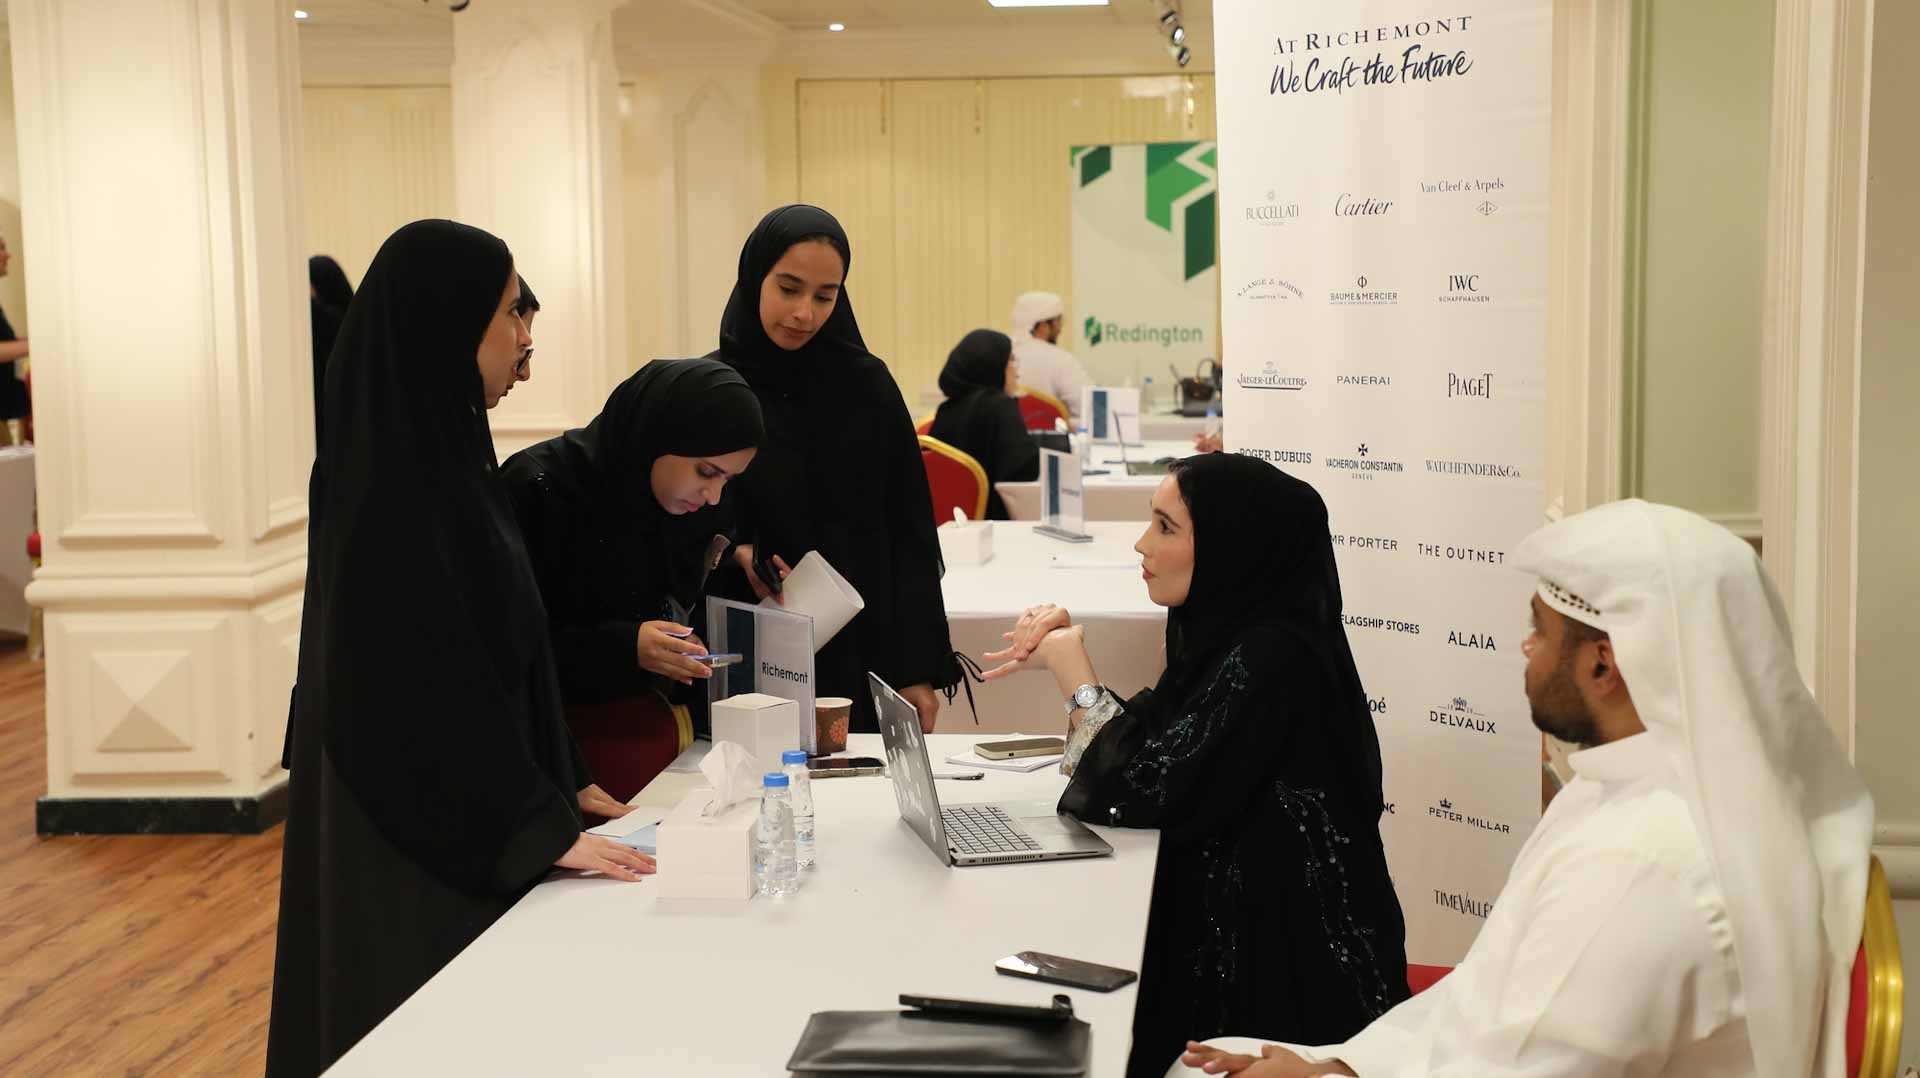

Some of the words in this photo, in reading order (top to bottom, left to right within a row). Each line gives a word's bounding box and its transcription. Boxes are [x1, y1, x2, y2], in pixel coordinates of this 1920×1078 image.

[1306, 16, 1472, 51] RICHEMONT
[1270, 60, 1301, 95] We
[1304, 57, 1361, 94] Craft
[1363, 53, 1399, 86] the
[1401, 44, 1474, 83] Future
[1464, 182, 1472, 191] &
[1475, 177, 1505, 193] Arpels
[1246, 204, 1299, 220] BUCCELLATI
[1335, 192, 1393, 217] Cartier
[1449, 274, 1480, 292] IWC
[1105, 322, 1203, 347] Redington
[1336, 375, 1391, 385] PANERAI
[1448, 372, 1493, 399] PIAGET
[1239, 448, 1272, 462] ROGER
[1274, 450, 1312, 464] DUBUIS
[1325, 458, 1359, 470] VACHERON
[1360, 460, 1404, 473] CONSTANTIN
[1349, 536, 1398, 551] PORTER
[1418, 543, 1441, 557] THE
[1446, 546, 1505, 565] OUTNET
[1386, 620, 1420, 635] STORES
[761, 662, 808, 684] Richemont
[1429, 710, 1496, 735] DELVAUX
[1429, 807, 1463, 823] PETER
[1467, 816, 1511, 834] MILLAR
